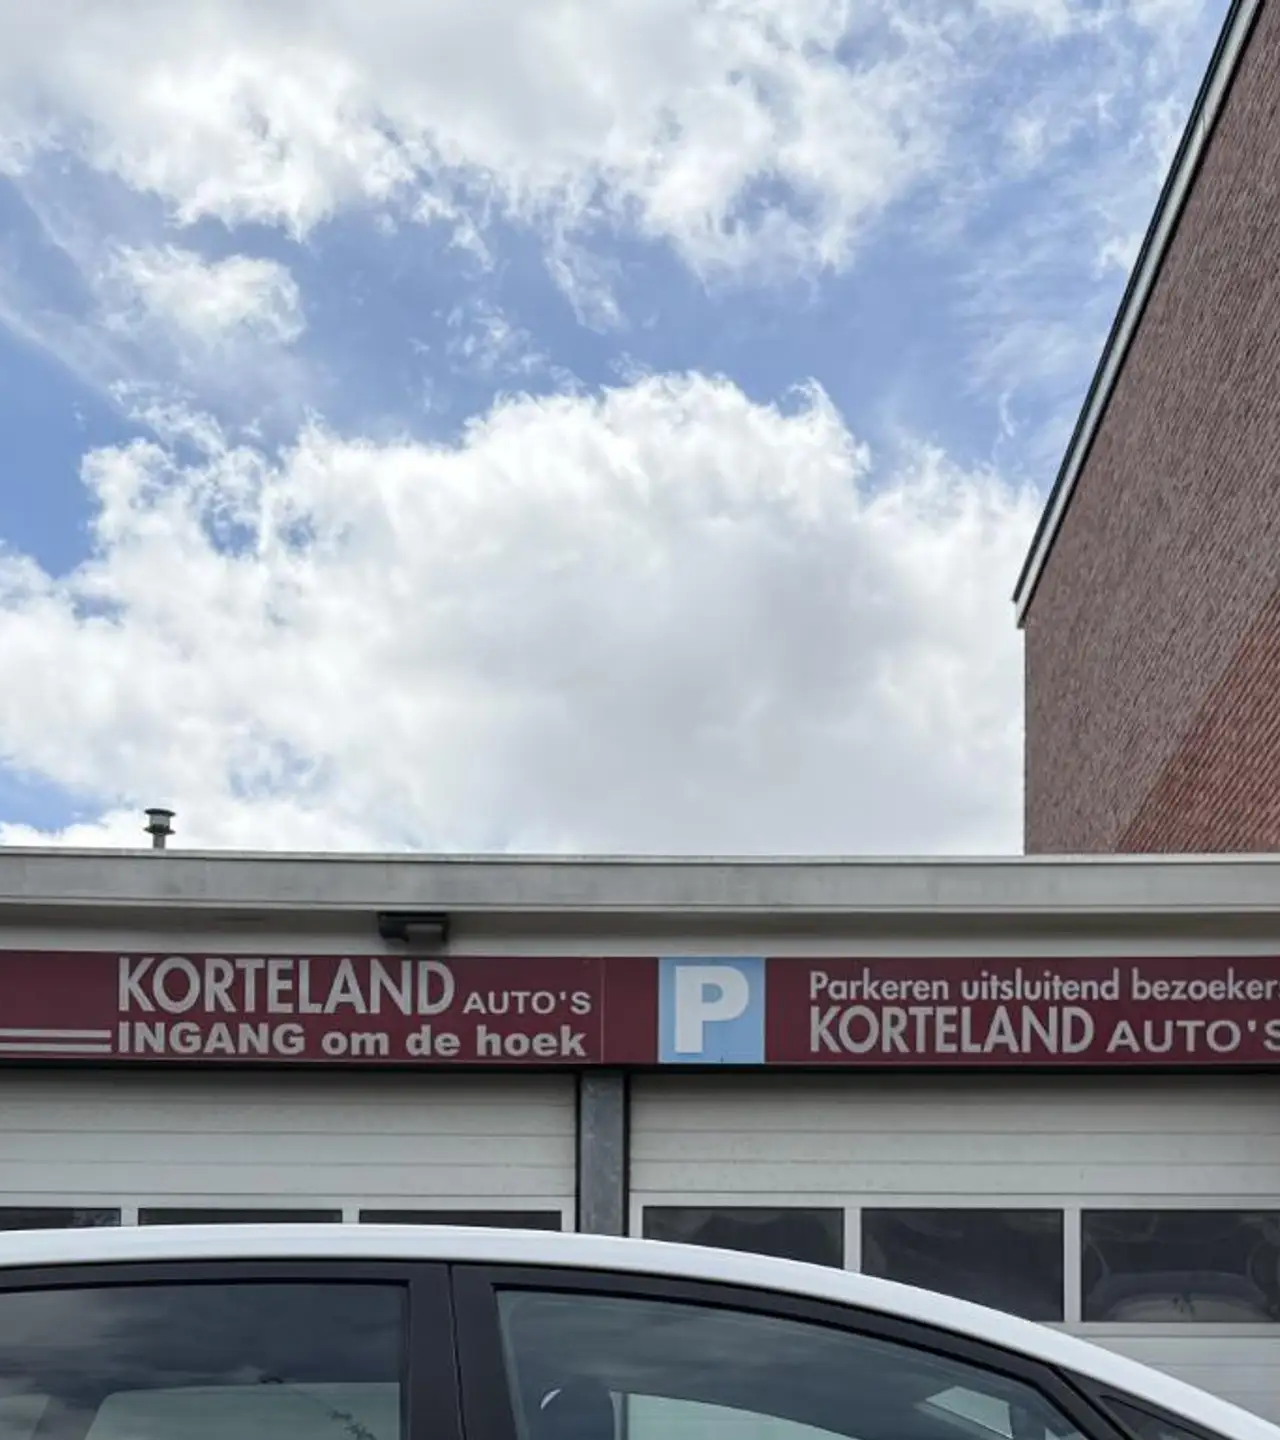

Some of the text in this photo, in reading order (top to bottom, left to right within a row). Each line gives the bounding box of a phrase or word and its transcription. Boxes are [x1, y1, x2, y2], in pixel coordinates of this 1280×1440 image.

[119, 957, 591, 1015] KORTELAND AUTO'S
[810, 968, 949, 1000] Parkeren
[961, 967, 1119, 1001] uitsluitend
[675, 964, 749, 1053] P
[810, 1005, 1094, 1053] KORTELAND
[119, 1021, 586, 1057] INGANG om de hoek
